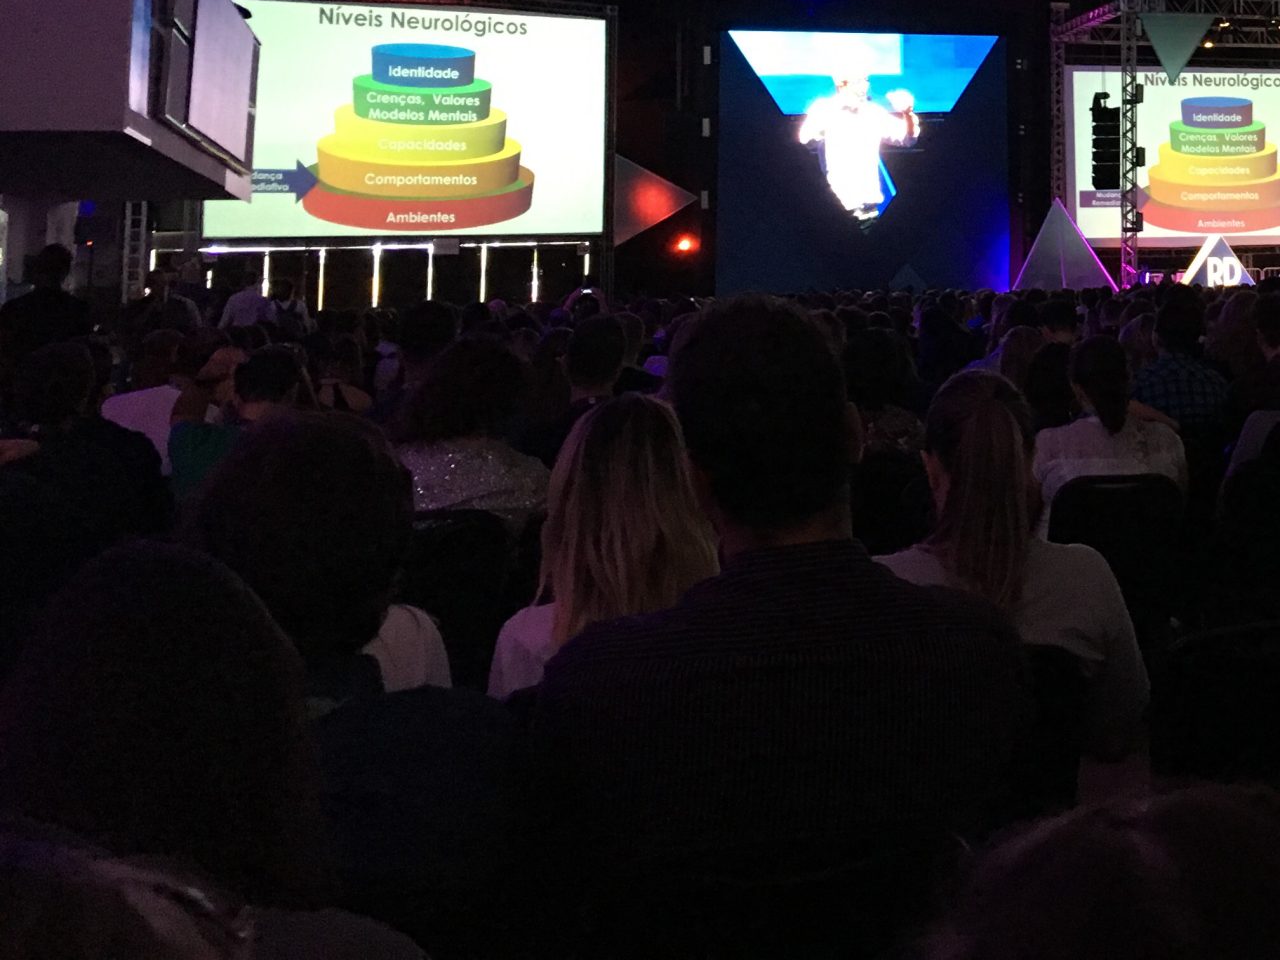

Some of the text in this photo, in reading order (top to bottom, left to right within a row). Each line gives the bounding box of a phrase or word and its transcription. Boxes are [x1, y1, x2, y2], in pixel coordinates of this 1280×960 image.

[318, 6, 528, 37] Níveis Neurológicos
[388, 65, 460, 79] Identidade
[366, 91, 480, 106] Crenças, Valores
[368, 108, 478, 121] Modelos Mentais
[1192, 112, 1242, 122] Identidade
[1224, 133, 1258, 142] Valores
[378, 139, 467, 153] Capacidades
[1181, 144, 1256, 153] Modelos Mentais
[1188, 165, 1250, 177] Capacidades
[364, 173, 478, 187] Comportamentos
[1181, 190, 1259, 202] Comportamentos
[386, 211, 456, 223] Ambientes
[1197, 219, 1246, 229] Ambientes
[1207, 256, 1242, 287] RD
